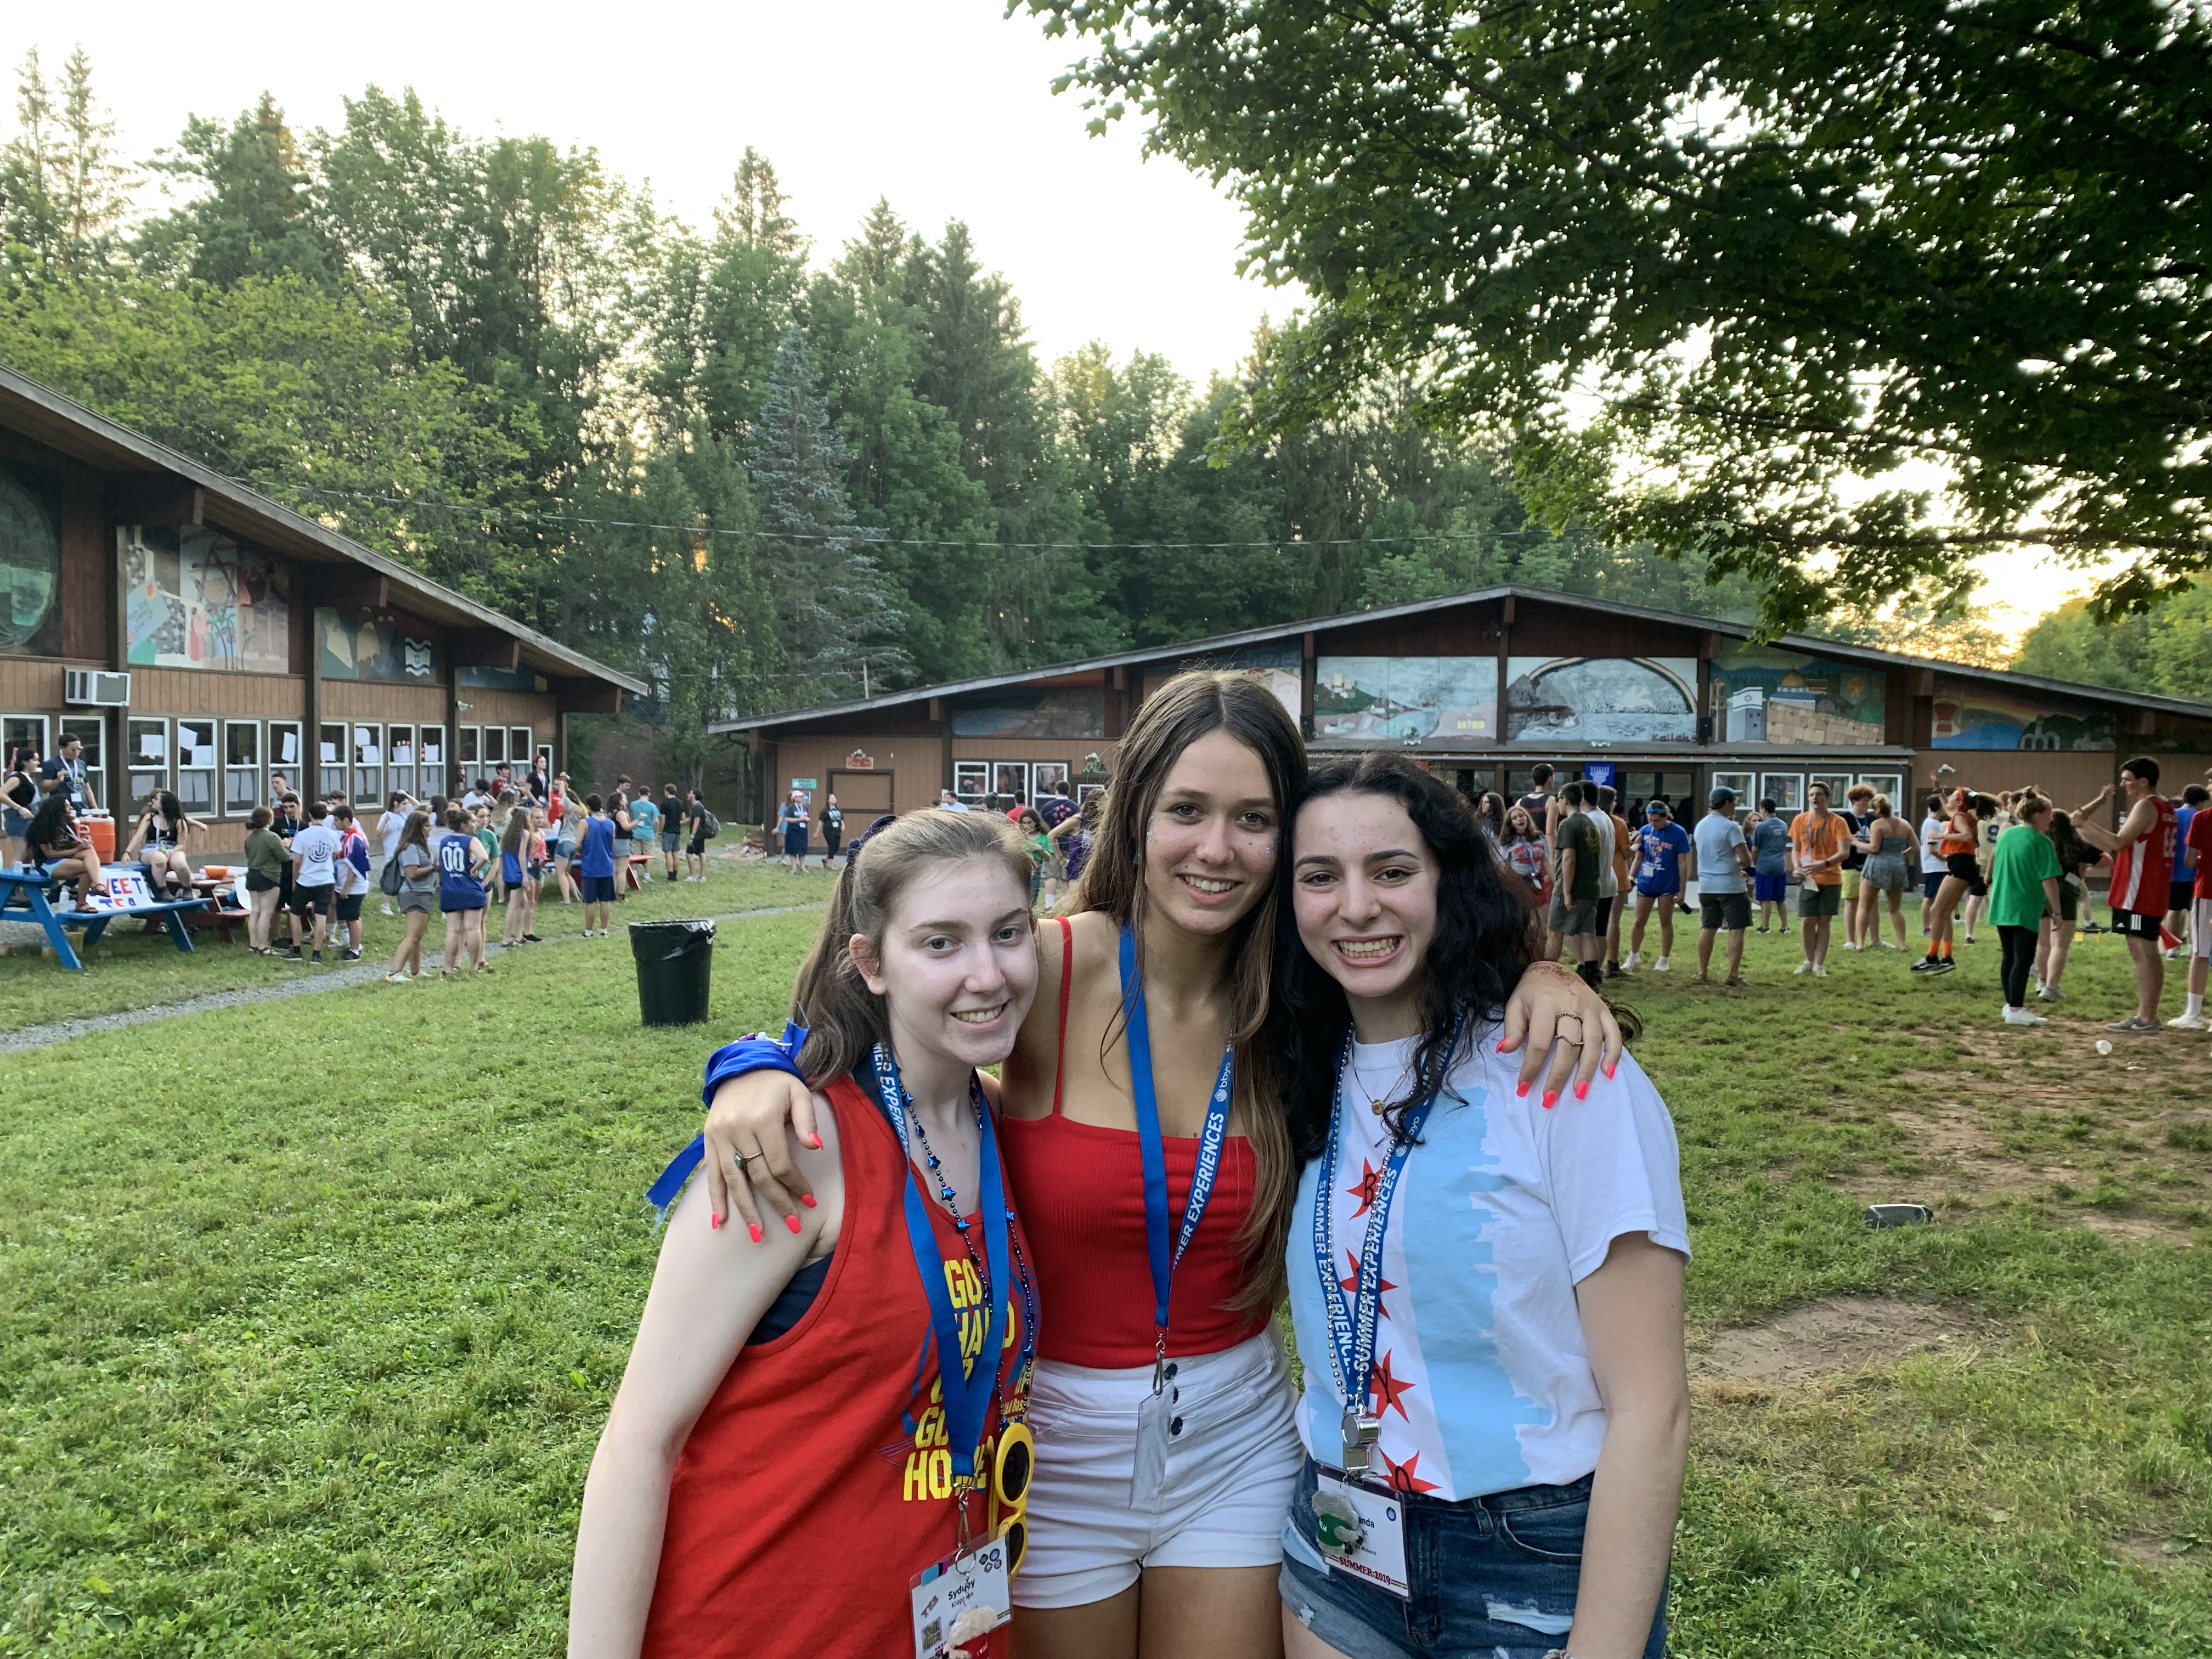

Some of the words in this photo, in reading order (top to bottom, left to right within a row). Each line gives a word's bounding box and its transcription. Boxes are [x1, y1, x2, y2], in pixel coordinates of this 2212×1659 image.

[442, 847, 465, 872] 00
[91, 877, 142, 896] EET
[873, 1042, 893, 1072] MER
[880, 1076, 910, 1152] EXPERIEN
[1173, 1224, 1193, 1269] MER
[1187, 1111, 1224, 1223] EXPERIENCES
[1363, 1173, 1377, 1207] B
[1315, 1180, 1327, 1254] SUMMER
[944, 1259, 982, 1308] GO
[954, 1301, 1015, 1359] HAD
[1353, 1295, 1375, 1373] SUMMER
[1374, 1368, 1392, 1404] Y
[903, 1444, 987, 1501] HOE
[1358, 1517, 1375, 1528] anda
[1339, 1556, 1372, 1577] SUMMER
[1374, 1570, 1391, 1585] 2019
[948, 1579, 975, 1600] Sydney
